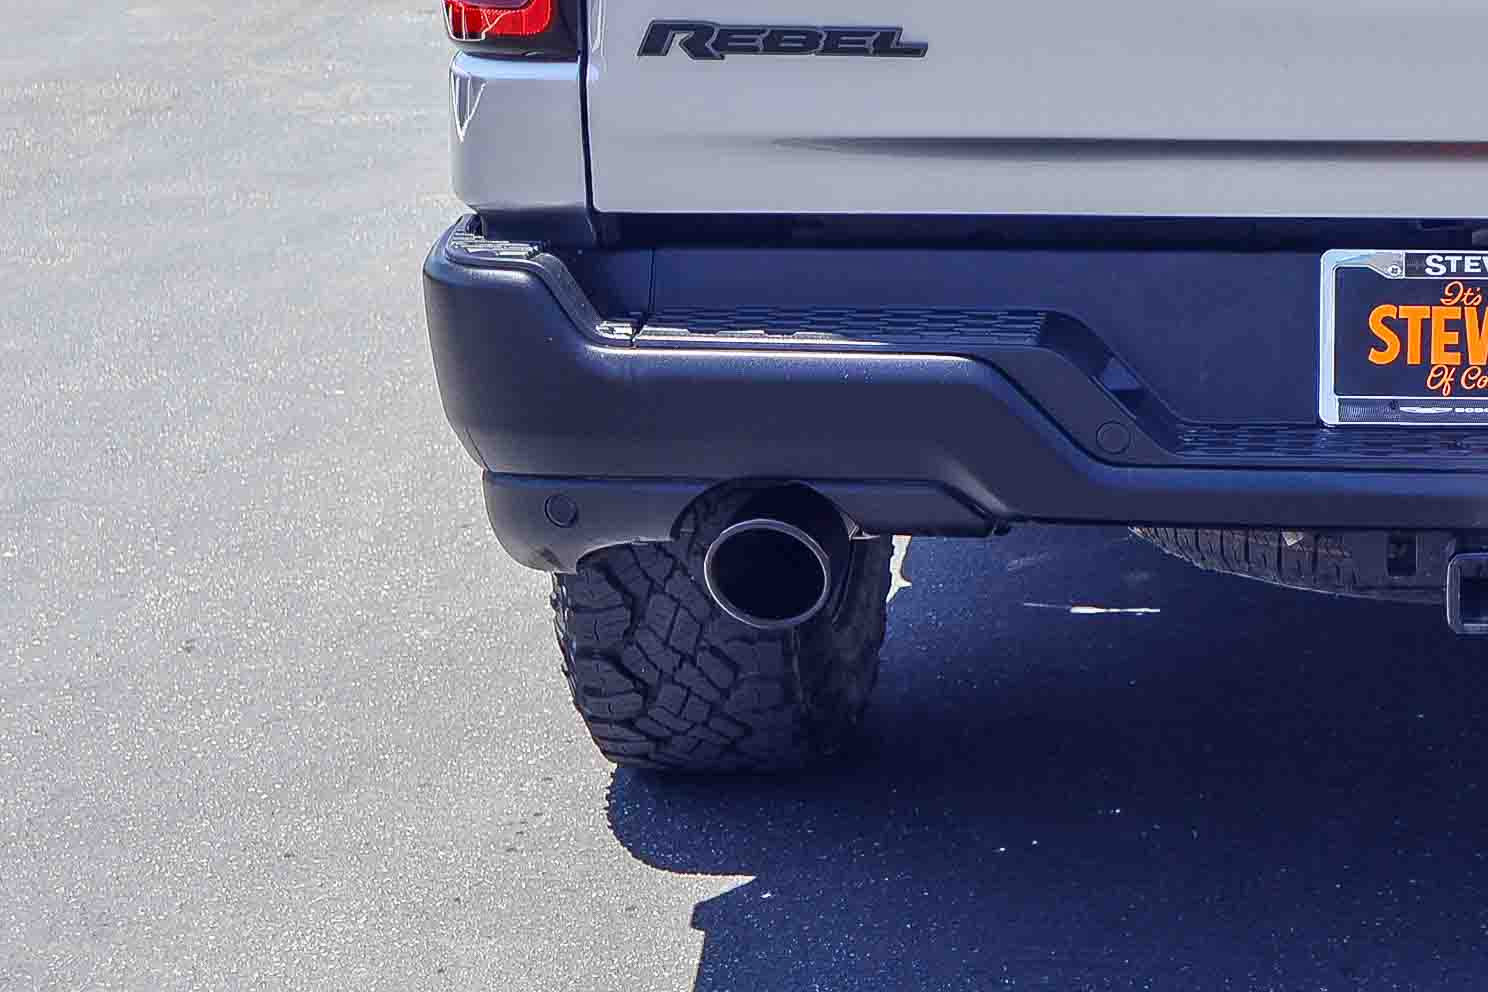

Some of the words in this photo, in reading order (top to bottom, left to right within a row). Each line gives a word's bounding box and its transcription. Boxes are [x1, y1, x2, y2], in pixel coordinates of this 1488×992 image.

[637, 19, 928, 60] REBEL
[1440, 280, 1482, 306] It's
[1426, 365, 1454, 396] Of
